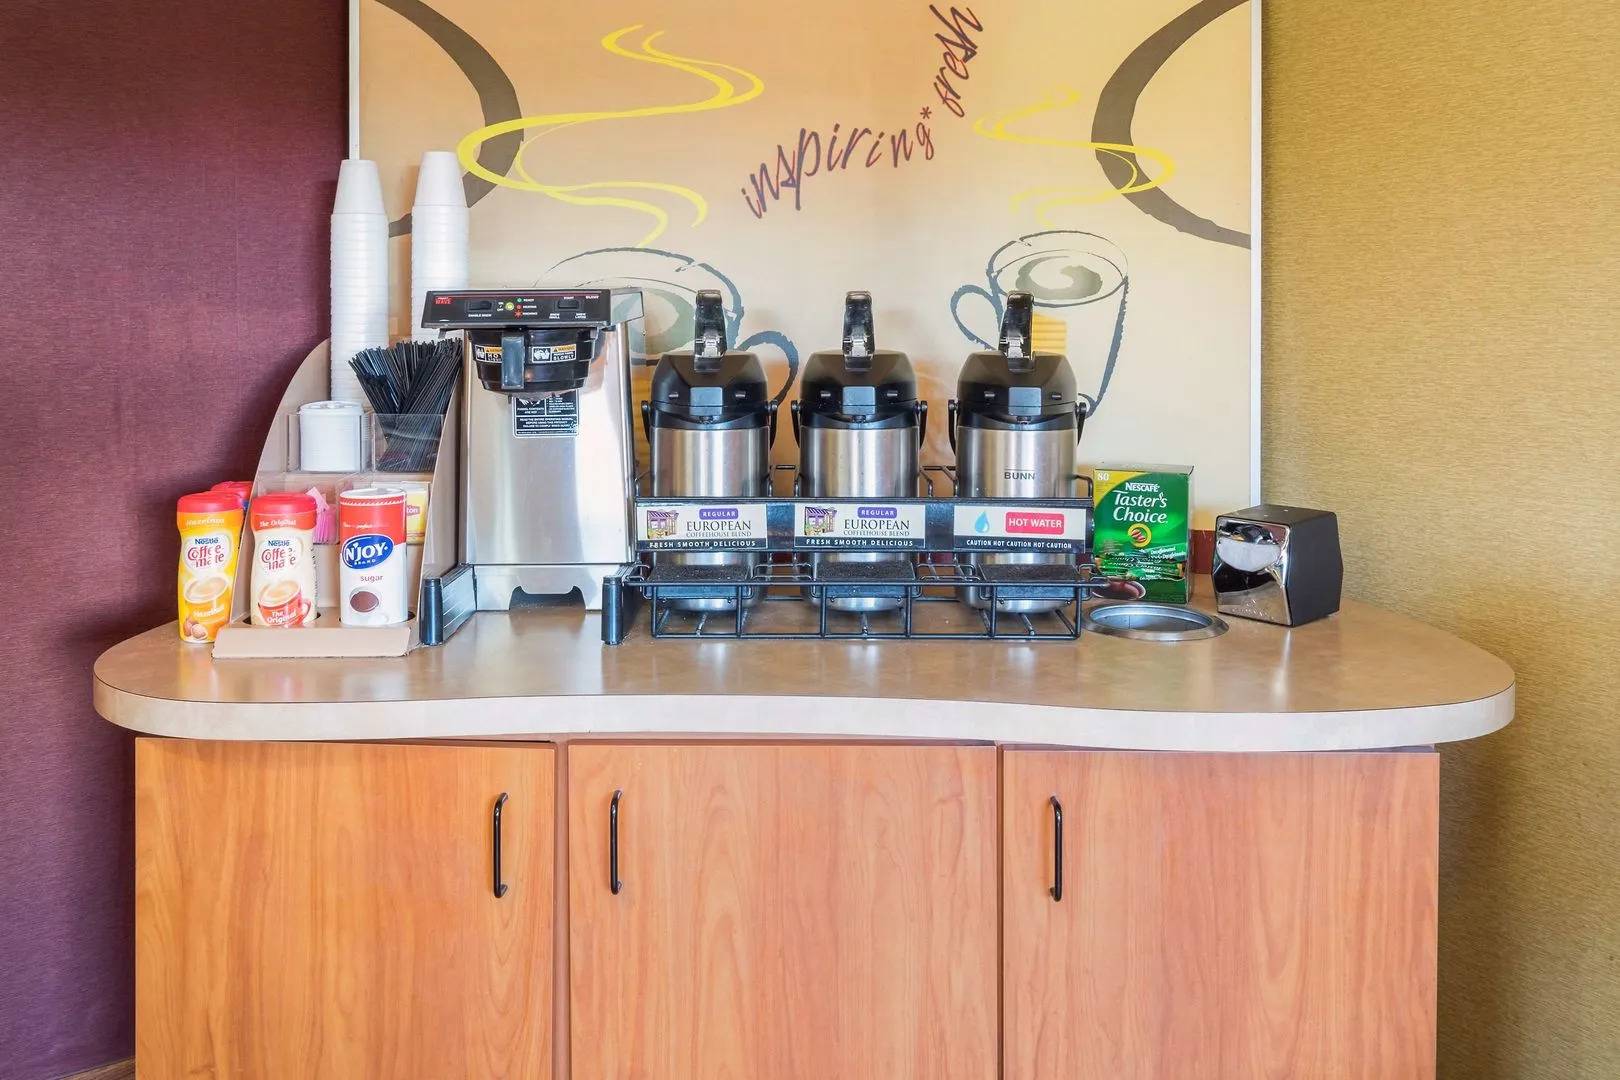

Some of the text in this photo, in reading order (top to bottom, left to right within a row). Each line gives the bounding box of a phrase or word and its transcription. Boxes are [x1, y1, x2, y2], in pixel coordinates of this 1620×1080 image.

[929, 3, 984, 118] fresh
[1004, 472, 1036, 480] BUNN
[1112, 490, 1168, 508] Taster's
[1113, 506, 1167, 524] Choice
[686, 520, 752, 532] EUROPEAN
[844, 519, 910, 530] EUROPEAN
[1008, 518, 1062, 528] HOT WATER
[267, 610, 297, 624] Original
